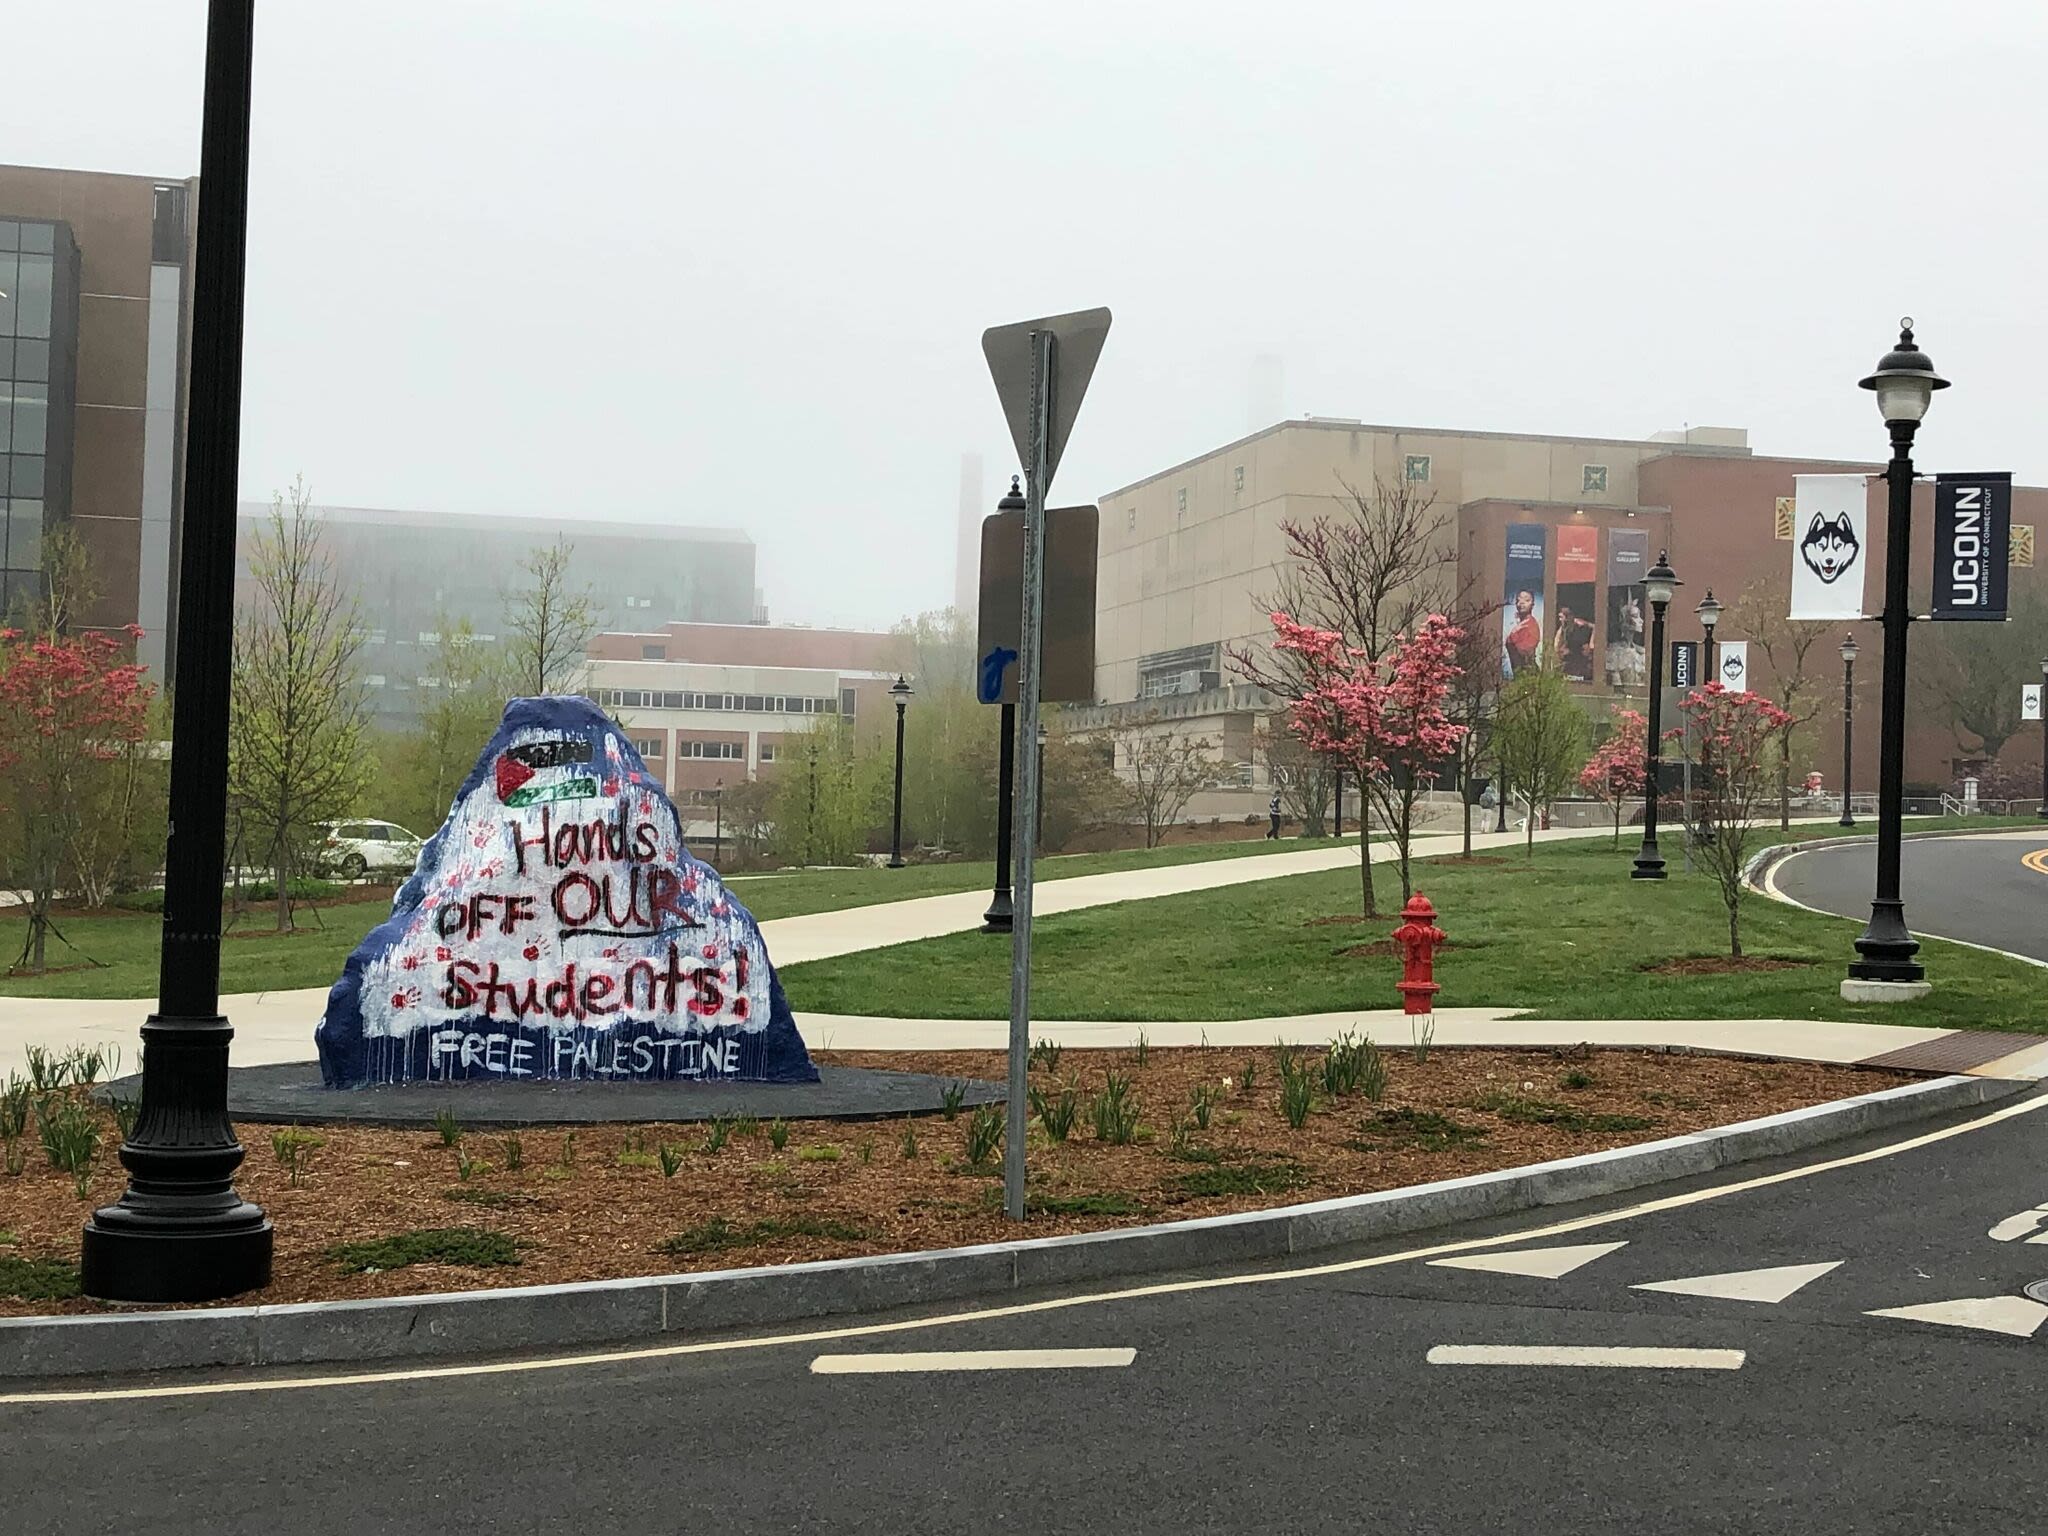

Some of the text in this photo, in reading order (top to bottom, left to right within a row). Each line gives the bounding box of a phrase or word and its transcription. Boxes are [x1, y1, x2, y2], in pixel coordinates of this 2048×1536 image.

[1952, 487, 1981, 605] UCONN
[1981, 487, 1992, 605] UNIVERSITY OF CONNECTICUT
[1677, 646, 1688, 688] UCONN
[513, 800, 658, 874] Hands
[438, 868, 698, 942] OFF OUR
[431, 1031, 741, 1075] FREE PALESTINE
